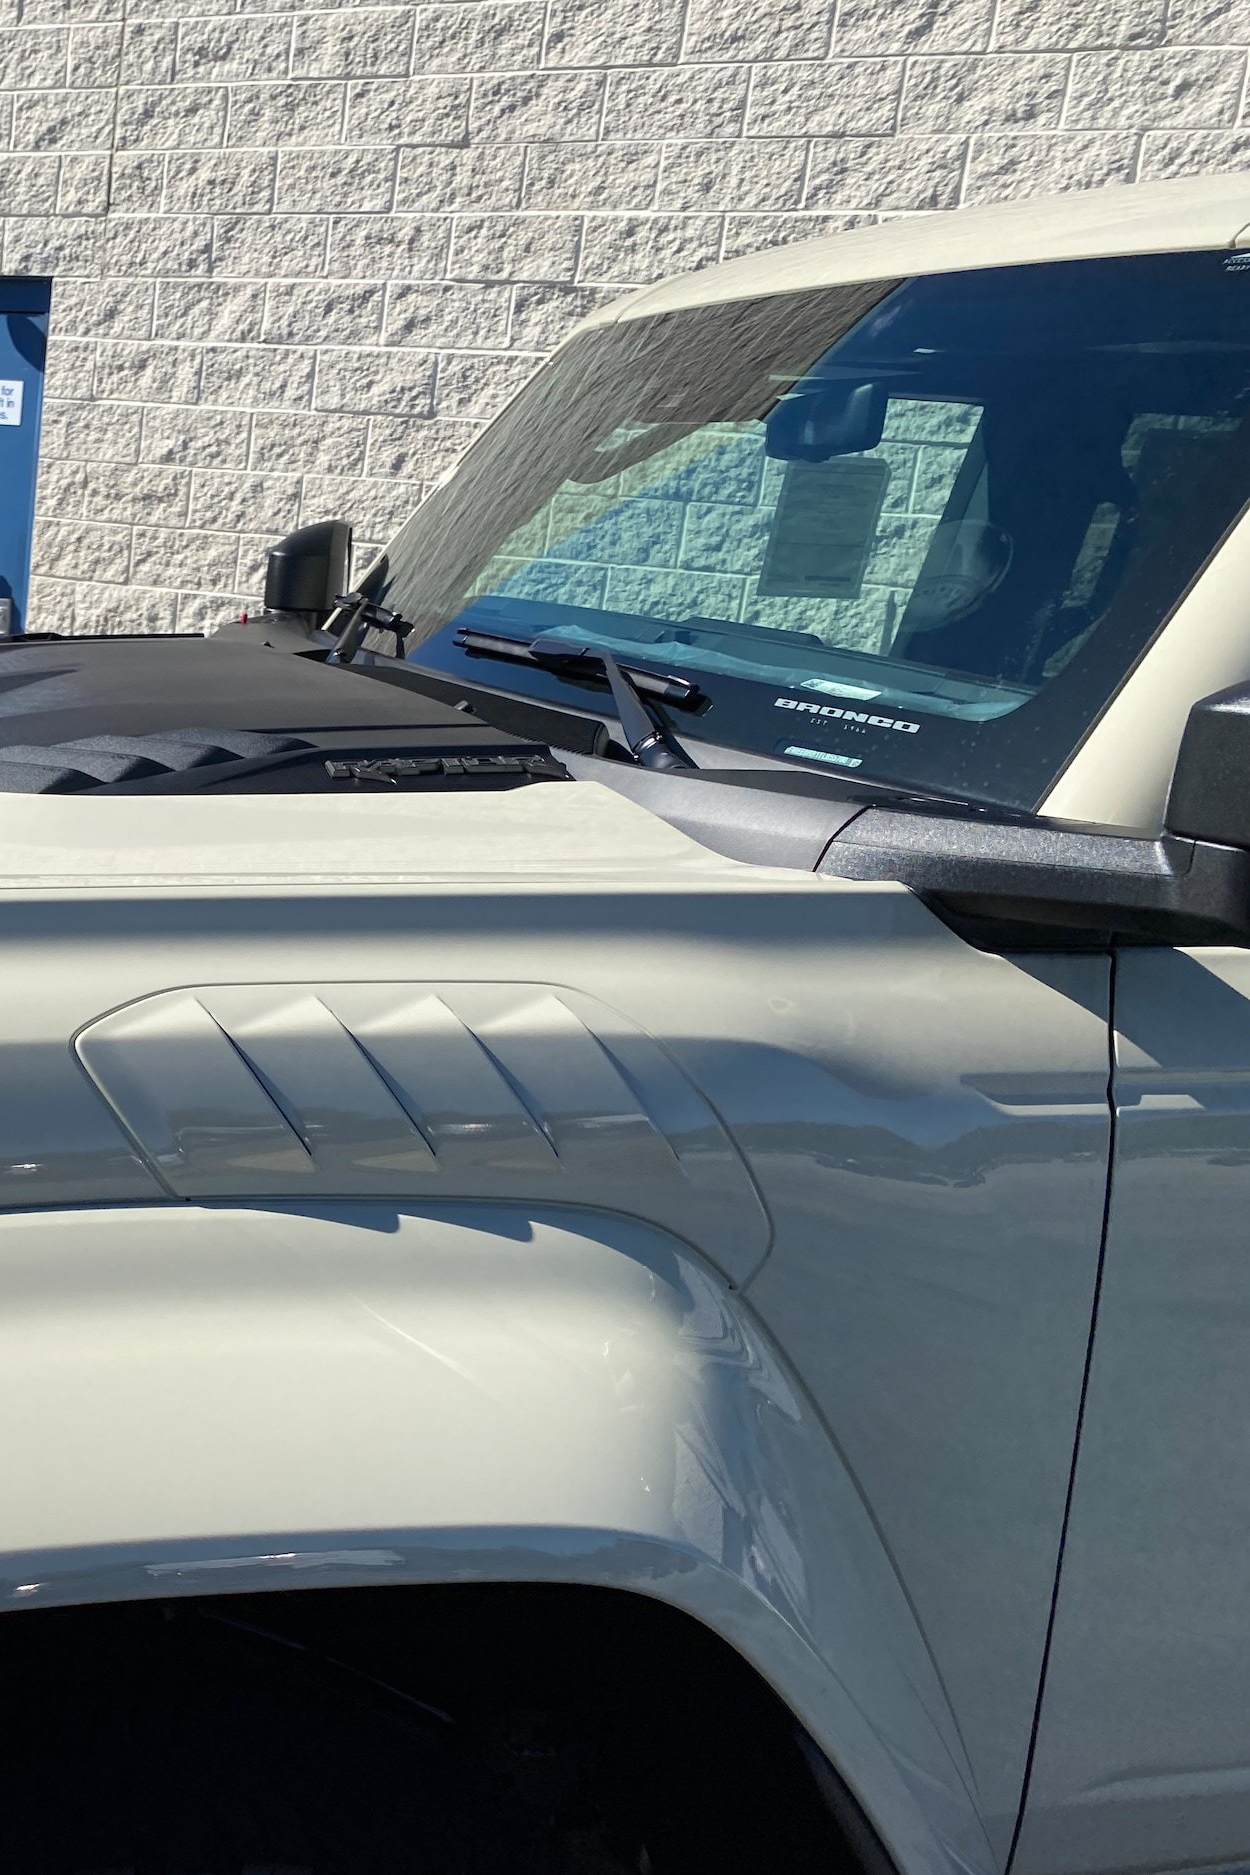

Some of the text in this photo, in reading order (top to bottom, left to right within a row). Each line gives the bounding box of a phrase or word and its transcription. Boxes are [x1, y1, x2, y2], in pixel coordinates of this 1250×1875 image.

[1, 386, 14, 397] for
[6, 398, 15, 408] in
[773, 697, 921, 734] BRONCO
[810, 717, 828, 727] EST
